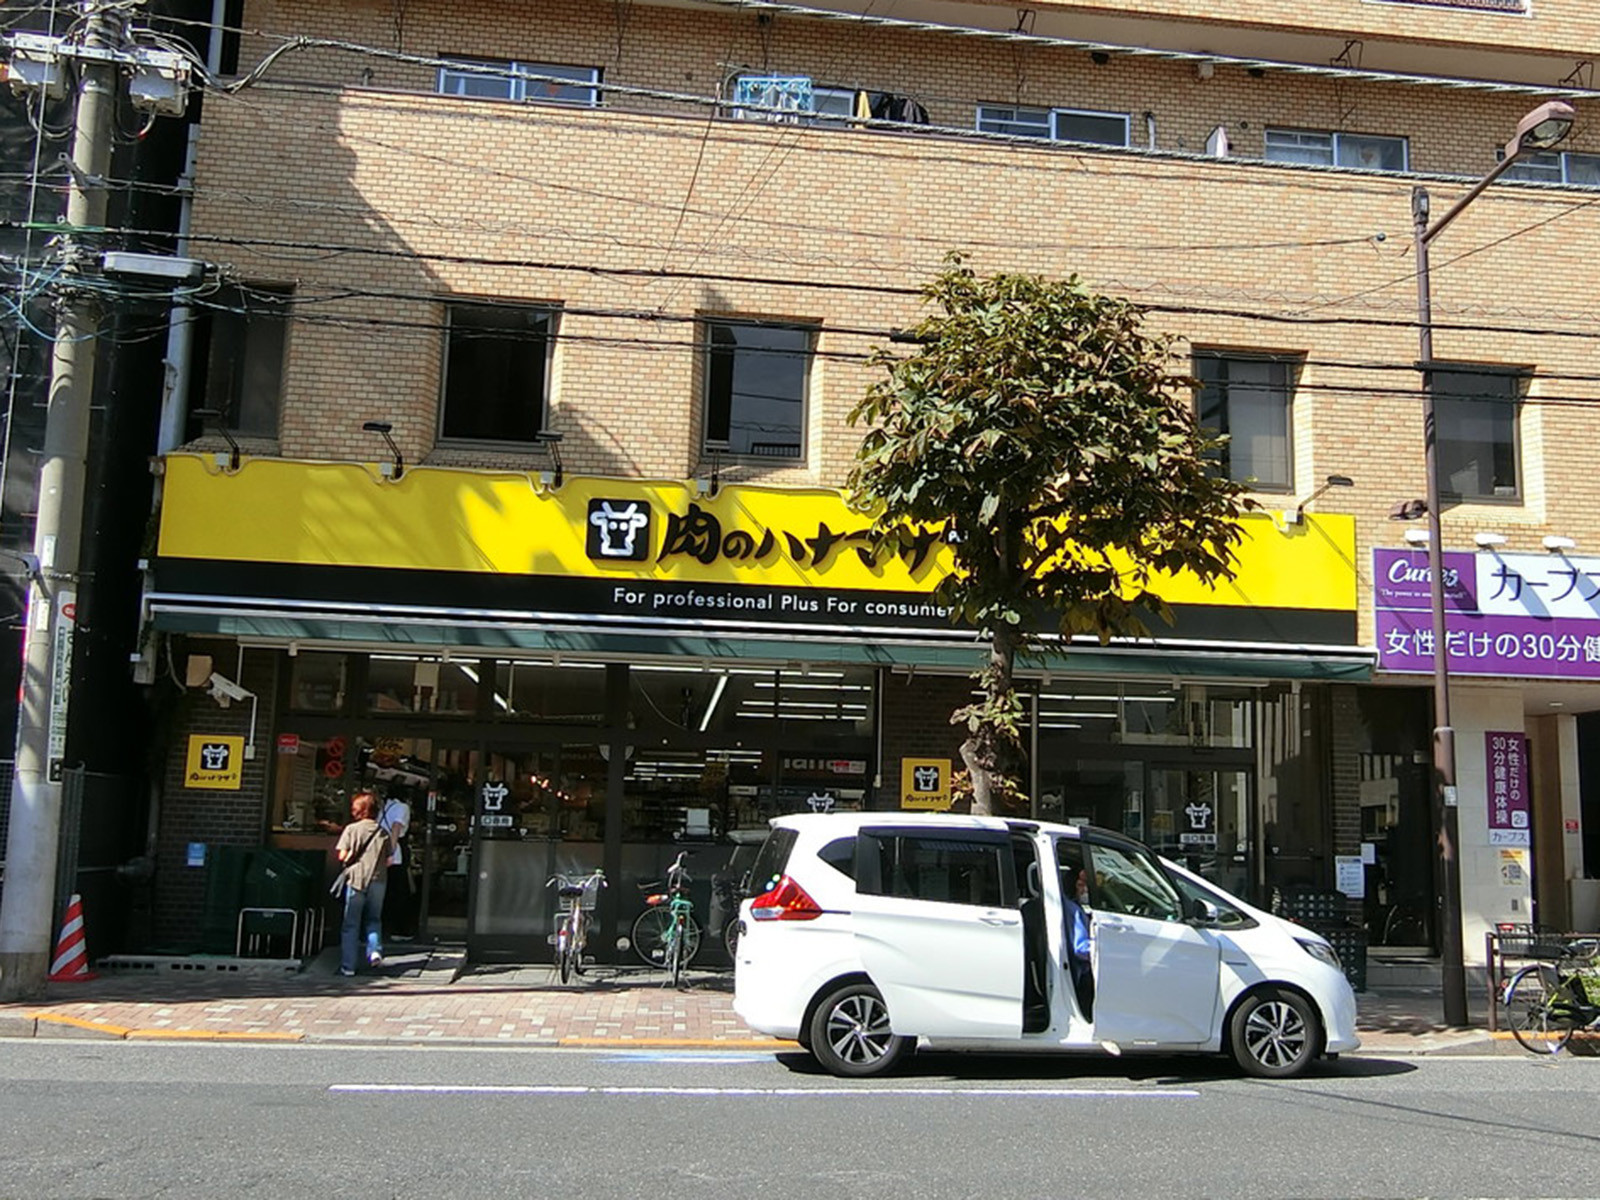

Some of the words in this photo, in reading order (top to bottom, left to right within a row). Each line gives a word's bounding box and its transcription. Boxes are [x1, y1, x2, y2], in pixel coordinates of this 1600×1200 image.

[656, 503, 942, 576] 肉のハナマサ
[613, 587, 646, 604] For
[653, 589, 773, 609] professional
[781, 594, 818, 611] Plus
[827, 597, 858, 613] For
[865, 601, 955, 618] consumer
[1507, 738, 1521, 801] 女性だけの
